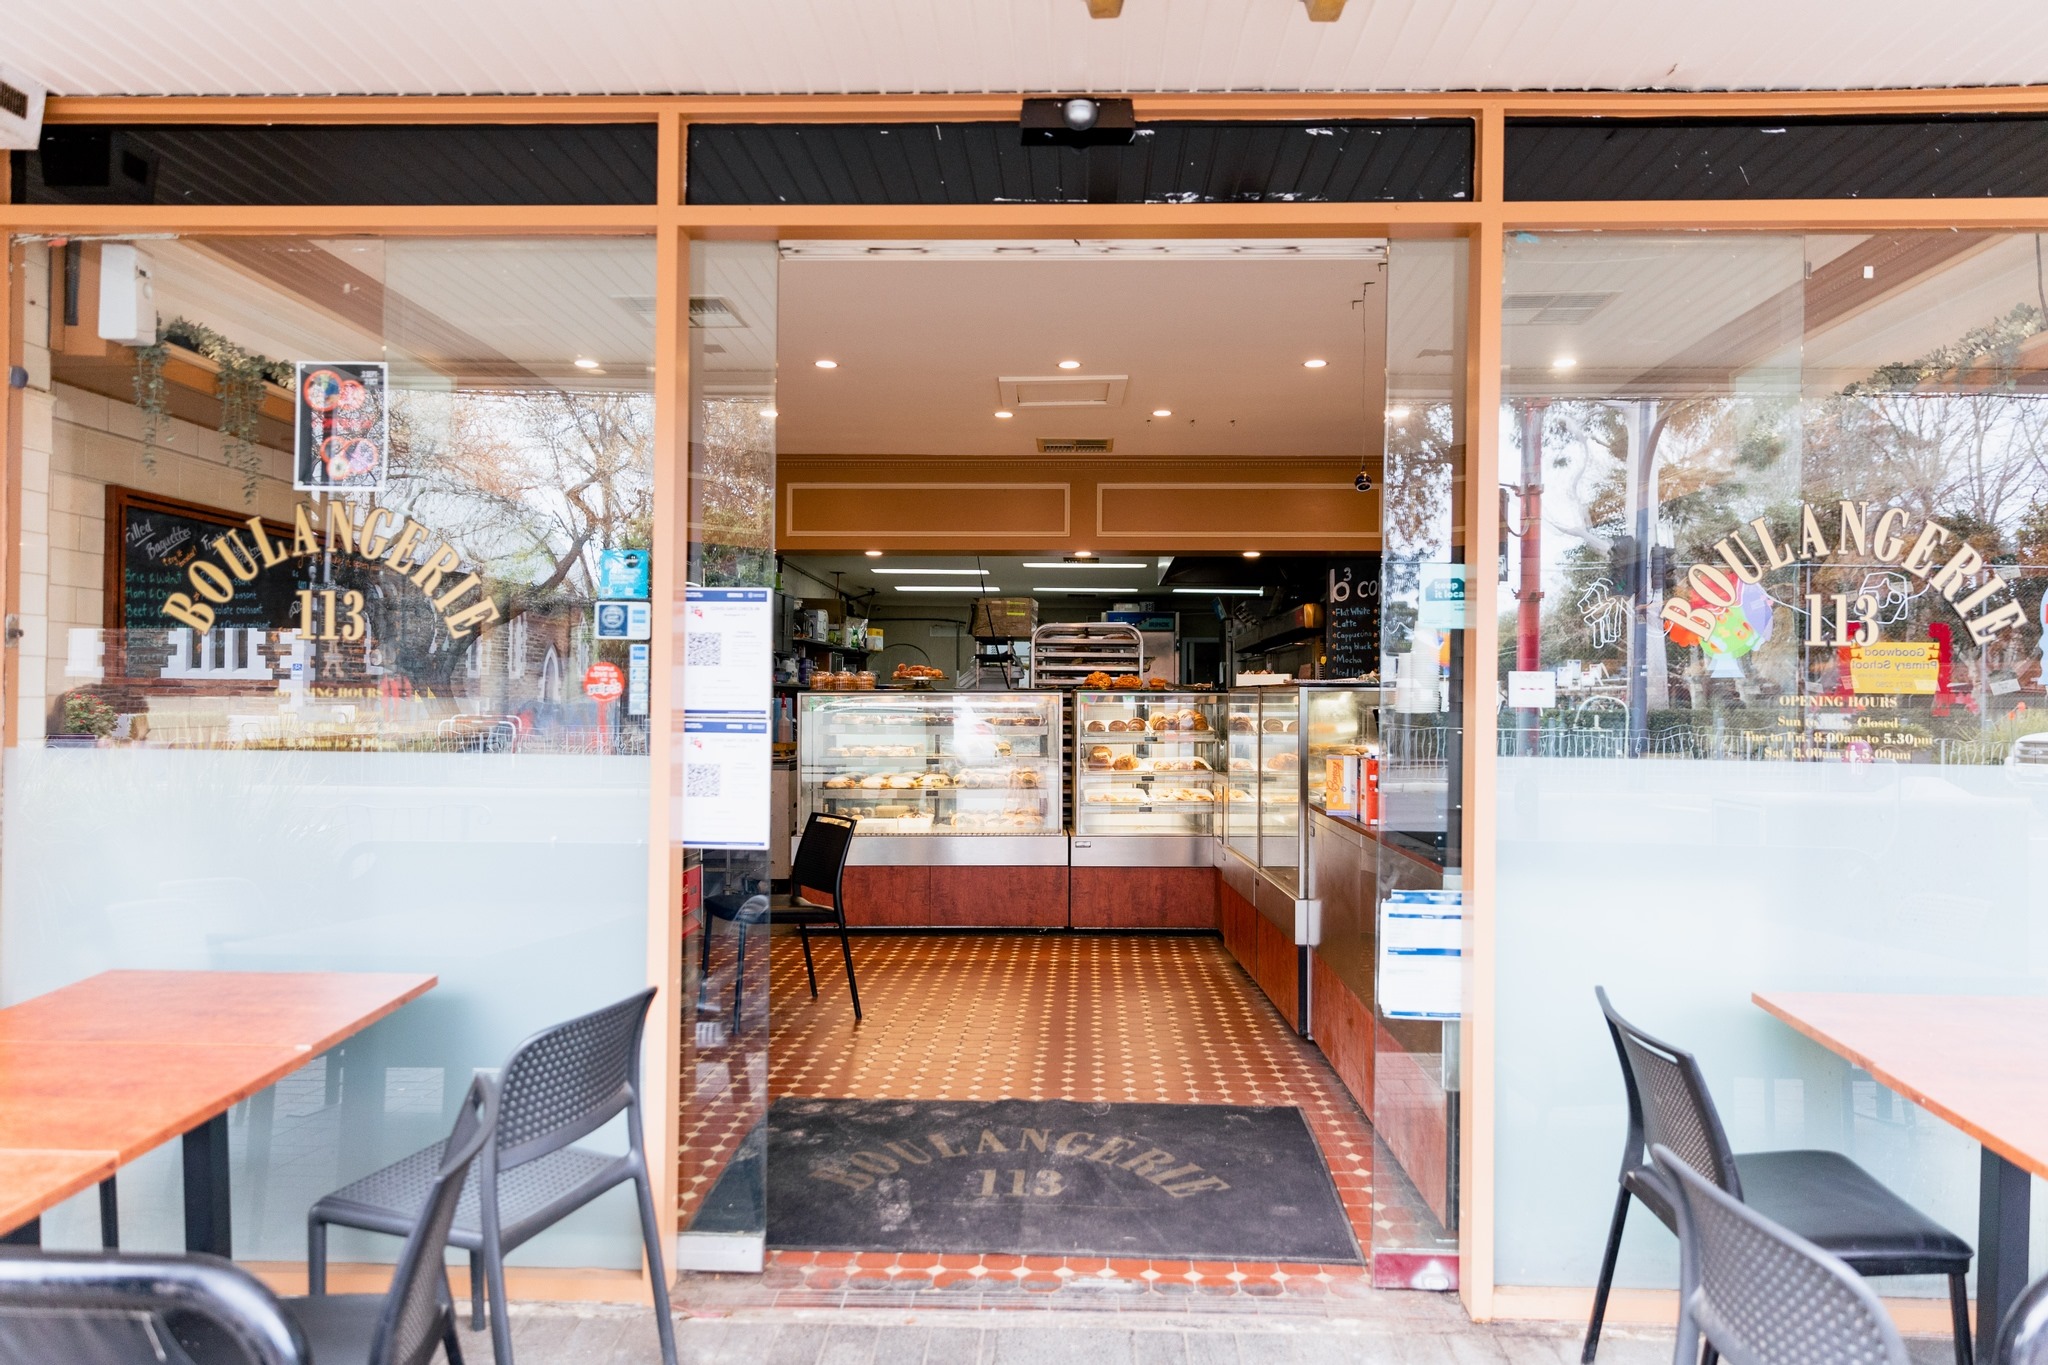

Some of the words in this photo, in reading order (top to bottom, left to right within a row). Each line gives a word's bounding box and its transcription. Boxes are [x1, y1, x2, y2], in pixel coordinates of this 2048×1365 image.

[162, 500, 501, 640] BOULANGERIE
[1660, 500, 2029, 646] BOULANGERIE
[1434, 581, 1459, 592] keep
[125, 589, 144, 600] Ham
[1434, 591, 1442, 599] it
[1444, 590, 1464, 599] loca
[126, 604, 143, 617] Beef
[295, 589, 366, 641] 113
[1335, 608, 1349, 616] Flat
[1350, 607, 1371, 616] White
[1336, 620, 1357, 628] Latte
[1804, 594, 1880, 647] 113
[1336, 630, 1372, 642] Cappuccino
[1336, 642, 1353, 653] Long
[1353, 642, 1372, 650] black
[1336, 655, 1362, 664] Mocha
[338, 687, 384, 698] HOURS
[1779, 695, 1844, 707] OPENING
[1848, 695, 1898, 708] HOURS
[1777, 716, 1802, 727] Sun
[1857, 716, 1899, 729] Closed
[1814, 732, 1863, 743] 8.00am
[1867, 733, 1879, 744] to
[1883, 733, 1933, 746] 5.30pm
[1862, 748, 1911, 761] 5.00pm
[808, 1127, 1231, 1199] BOULANGERIE
[975, 1168, 1067, 1198] 113
